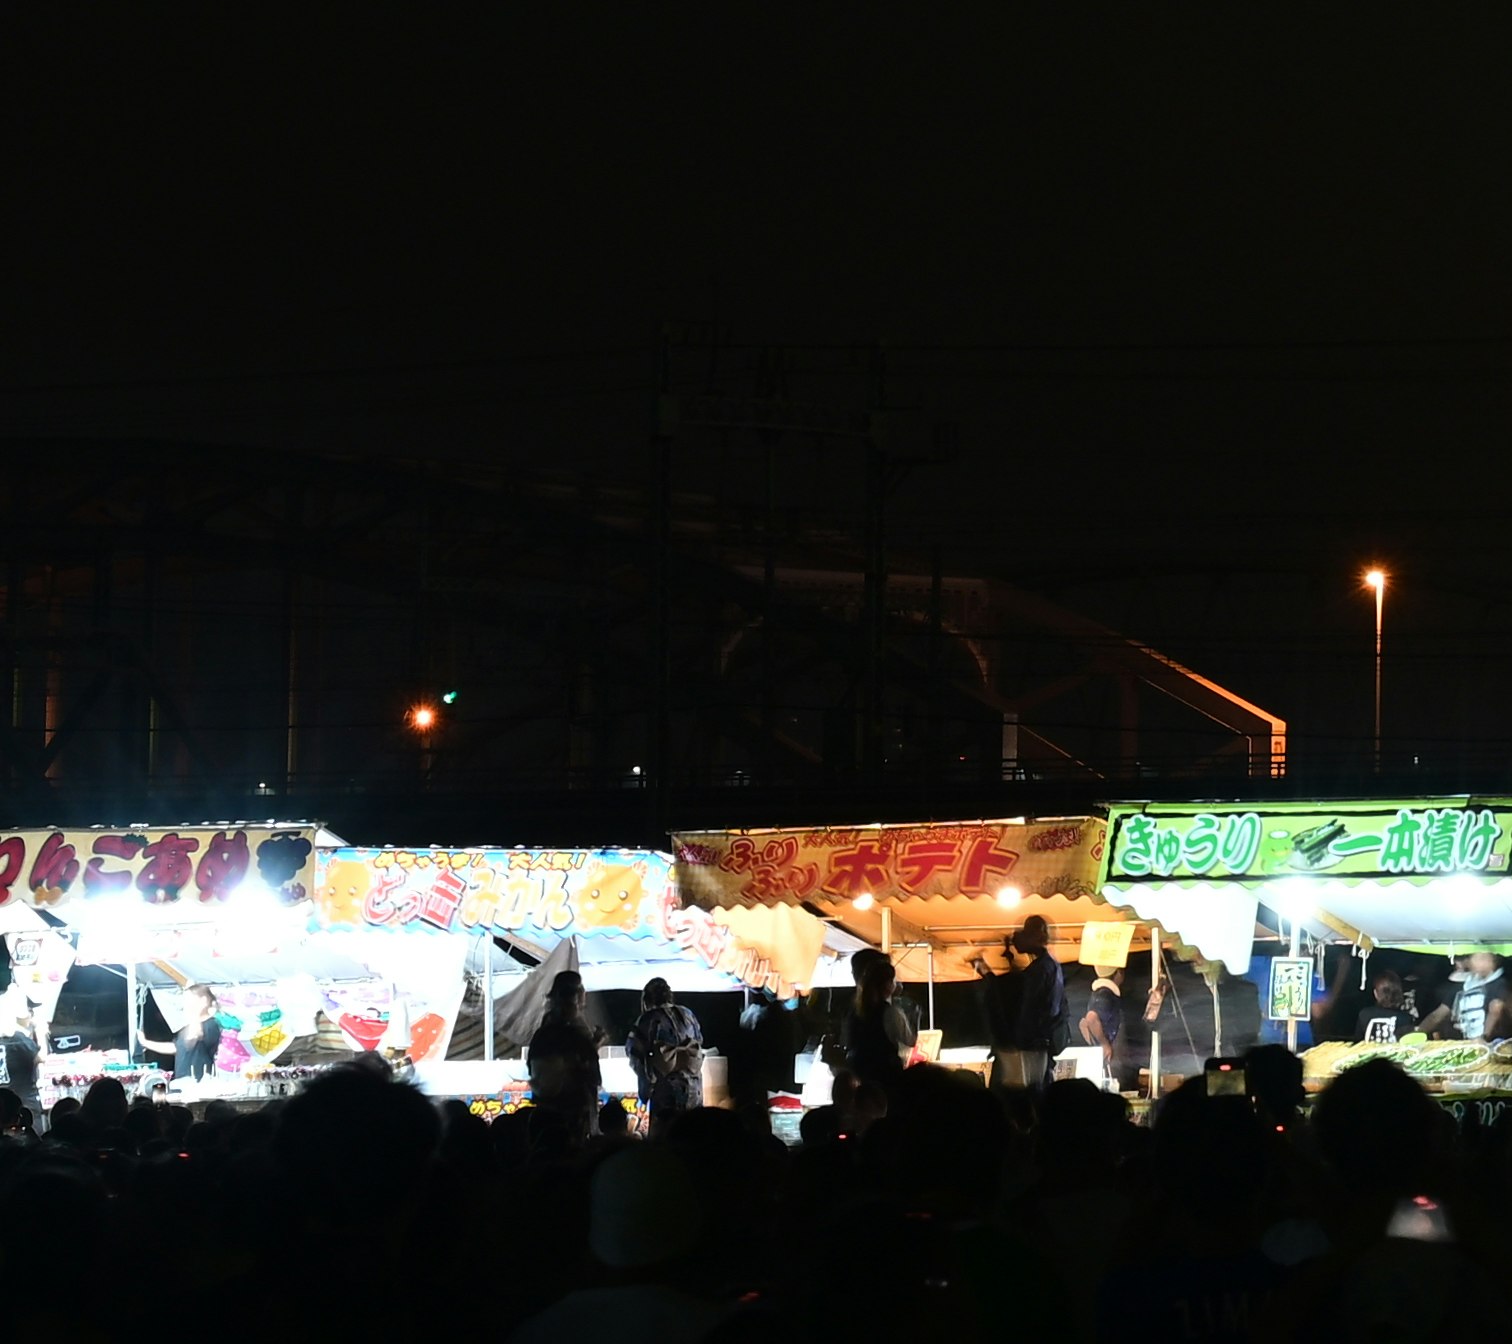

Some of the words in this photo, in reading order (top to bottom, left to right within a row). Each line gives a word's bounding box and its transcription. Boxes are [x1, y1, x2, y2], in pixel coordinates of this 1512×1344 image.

[822, 837, 1020, 896] ポテト
[1121, 813, 1262, 876] きゅうり
[1329, 809, 1500, 873] 一本漬け
